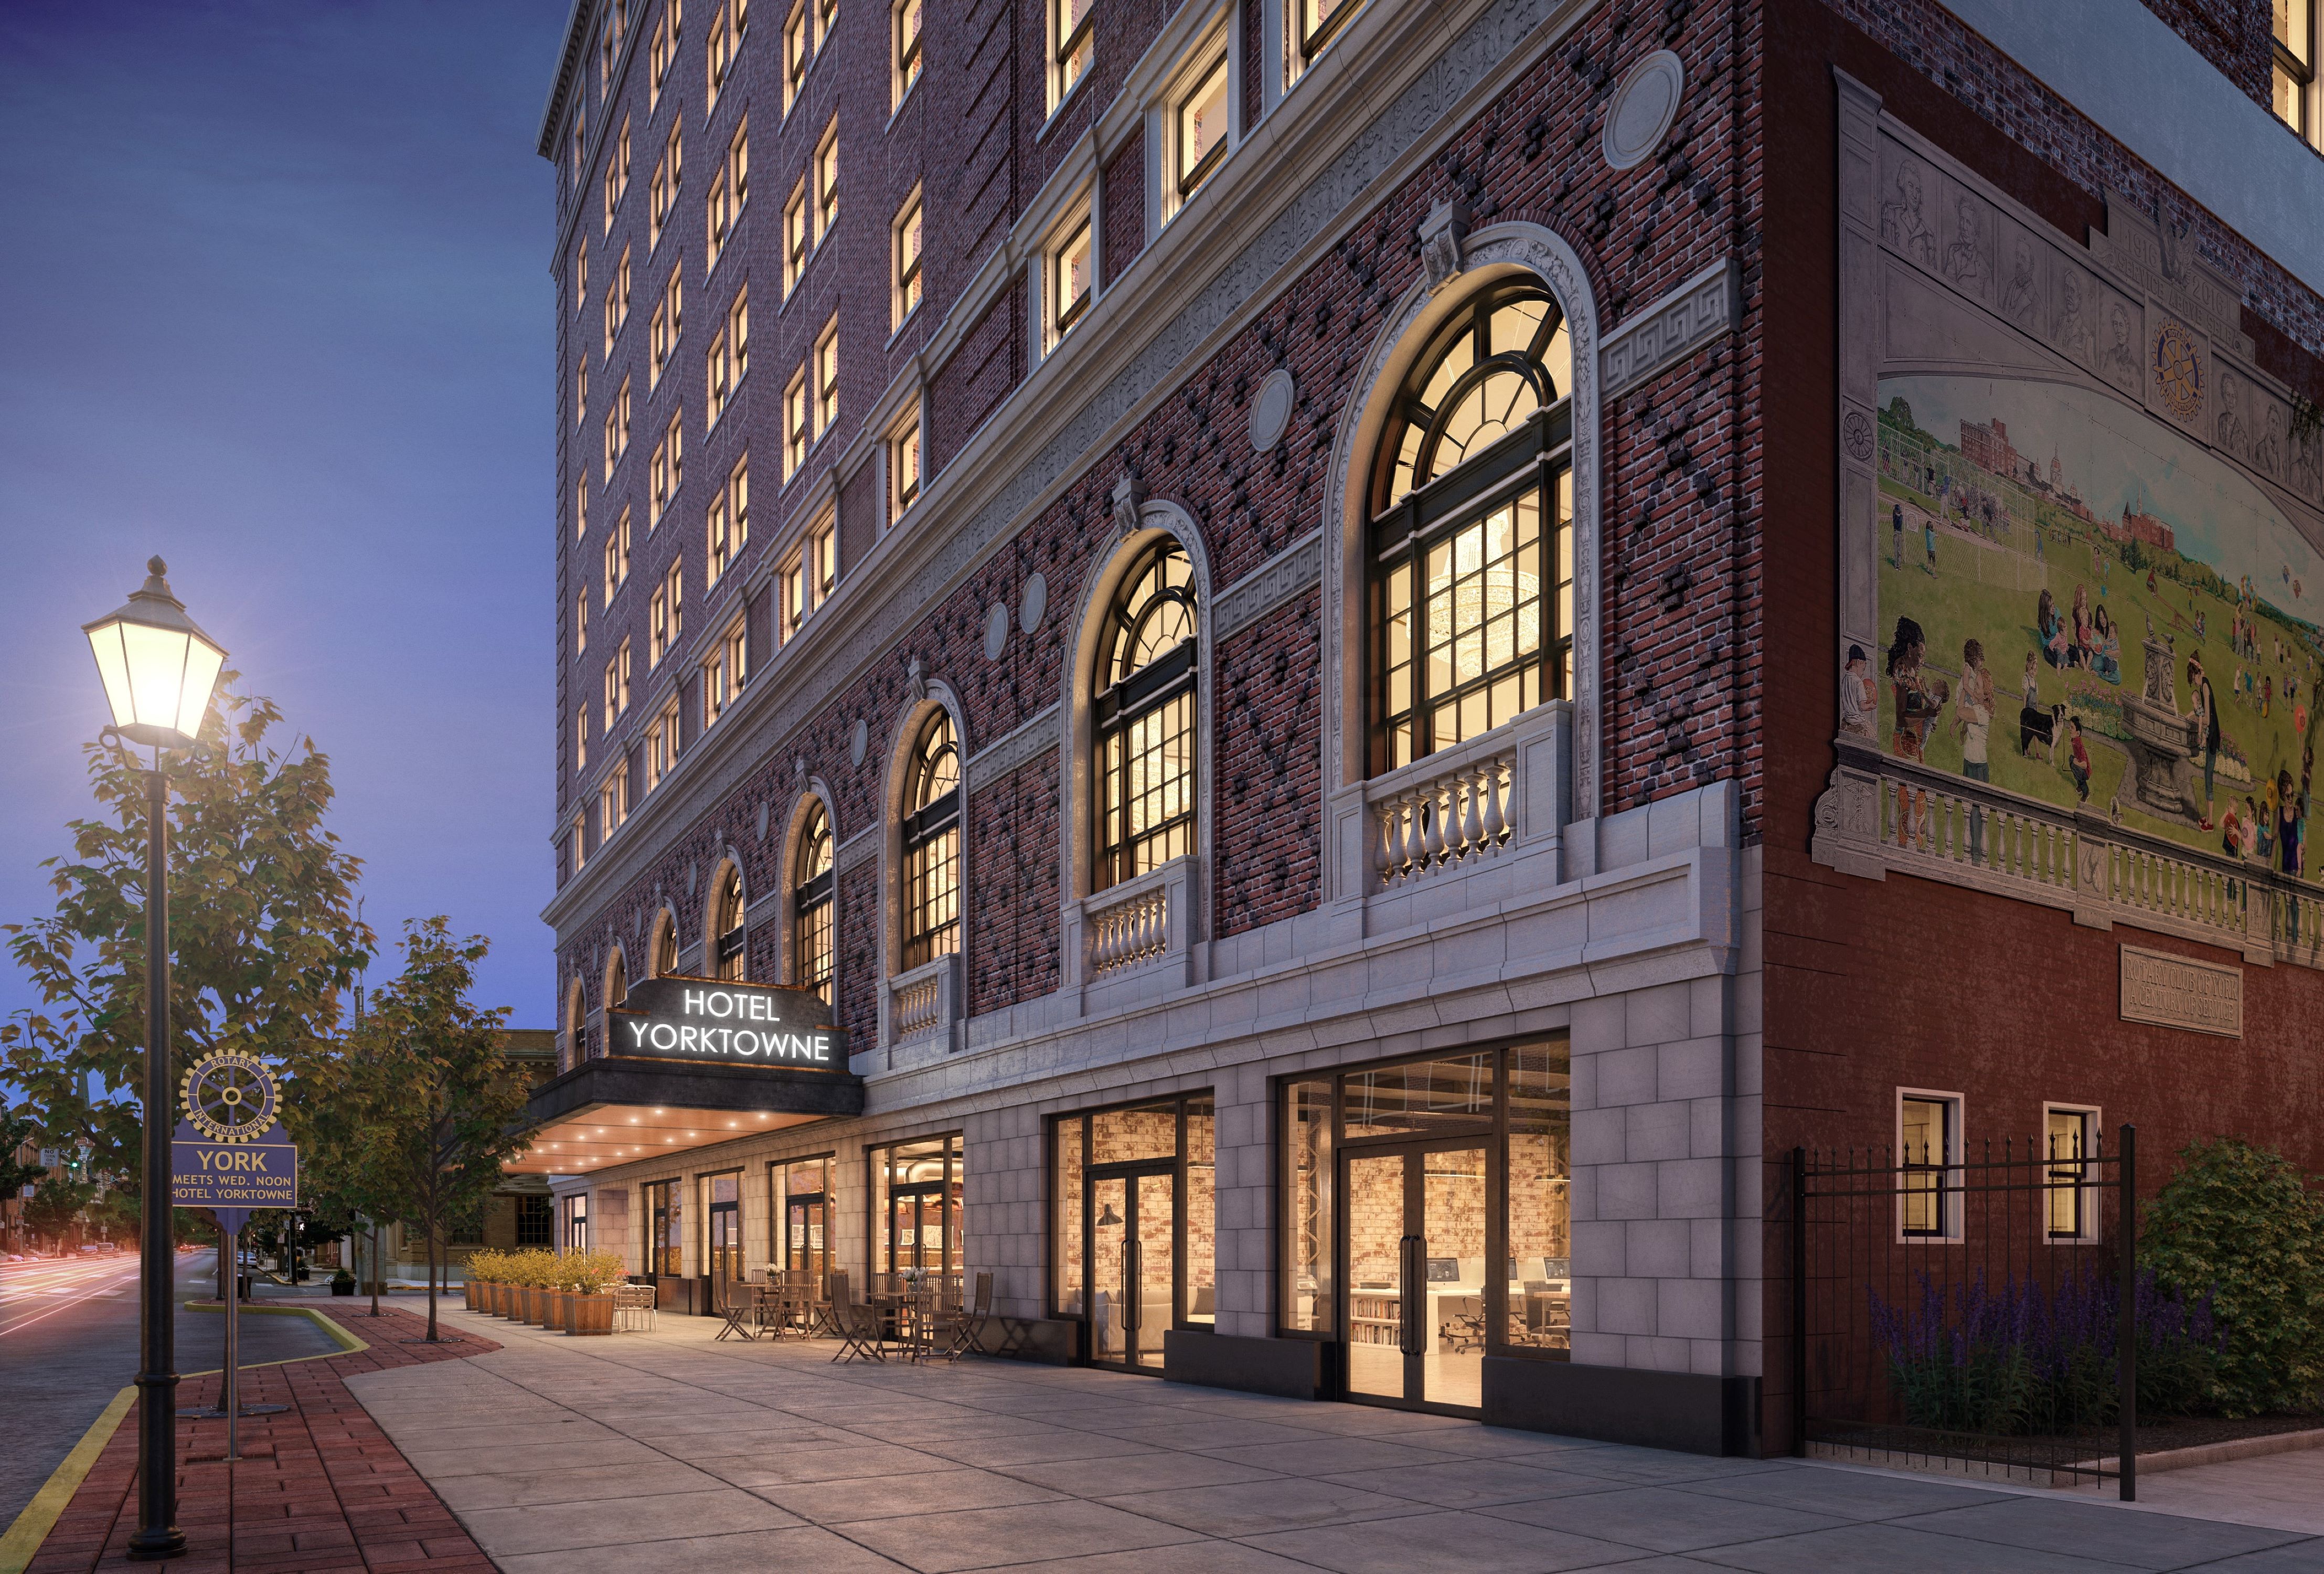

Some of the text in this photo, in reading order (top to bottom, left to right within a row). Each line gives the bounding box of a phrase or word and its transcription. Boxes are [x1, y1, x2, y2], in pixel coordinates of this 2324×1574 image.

[2117, 252, 2164, 300] SERVICE
[2128, 228, 2226, 316] 1916 2016
[2168, 329, 2189, 347] ROTARY
[2126, 956, 2237, 1001] ROTARY CLUB OF YORK
[685, 989, 780, 1022] HOTEL
[2129, 984, 2233, 1022] A CENTURY OF SERVICE
[630, 1022, 829, 1061] YORKTOWNE
[211, 1057, 252, 1068] ROTARY
[194, 1109, 269, 1136] INTERNATIONAL
[197, 1151, 267, 1171] YORK
[172, 1175, 291, 1186] MEETS WED. NOON
[172, 1188, 292, 1200] HOTEL YORKTOWNE
